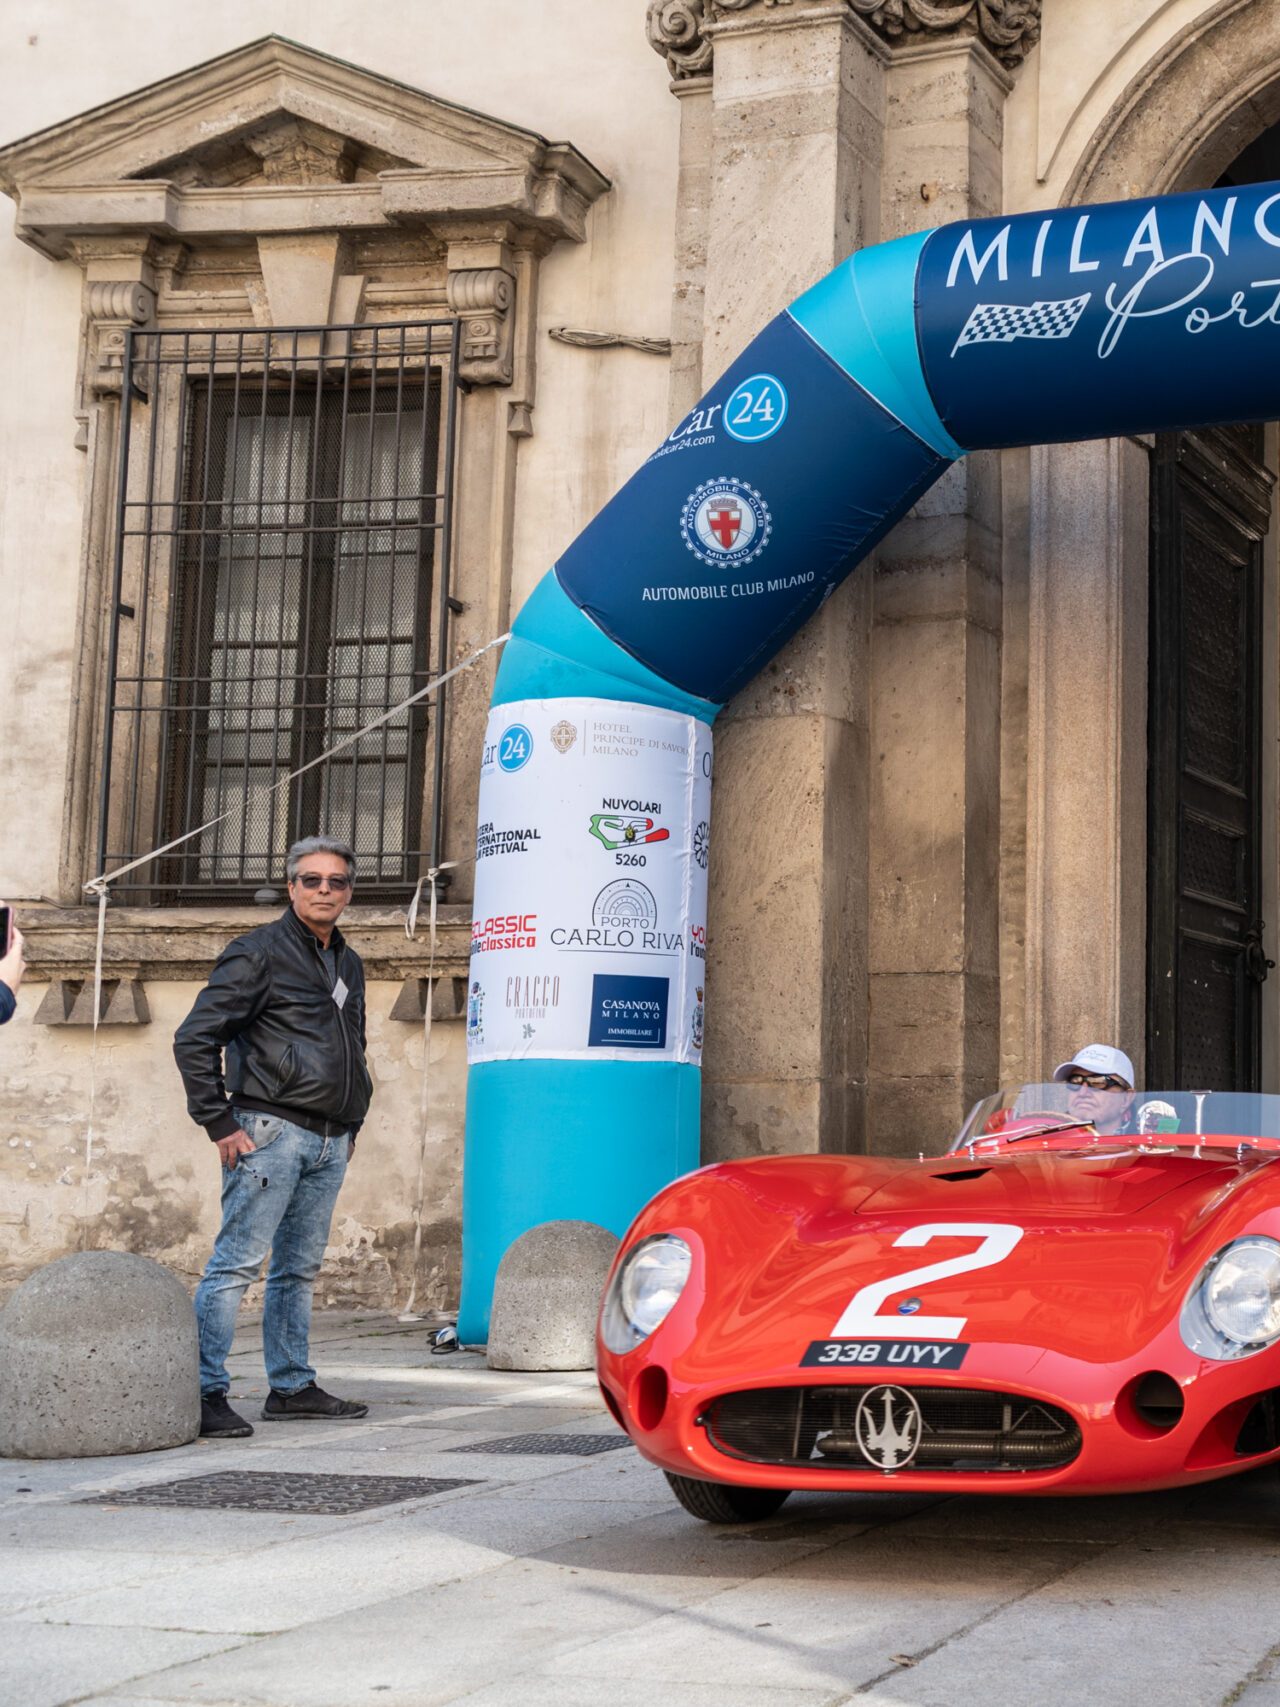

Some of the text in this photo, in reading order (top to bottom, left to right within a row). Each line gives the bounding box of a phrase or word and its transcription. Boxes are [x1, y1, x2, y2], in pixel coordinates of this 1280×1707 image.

[733, 387, 775, 424] 24
[687, 484, 764, 530] AUTOMOBILE CLUB
[705, 547, 750, 561] MILANO
[642, 586, 728, 601] AUTOMOBILE
[731, 582, 764, 597] CLUB
[767, 571, 815, 592] MILANO
[593, 722, 632, 734] HOTEL
[502, 733, 526, 761] 24
[593, 733, 646, 747] PRINCIPE
[649, 739, 659, 749] DI
[593, 745, 639, 757] MILANO
[602, 798, 662, 815] NUVOLARI
[615, 853, 647, 867] 5260
[601, 916, 650, 929] PORTO
[550, 928, 634, 948] CARLO
[643, 932, 684, 950] RIVA
[506, 975, 560, 1008] CRACCO
[602, 999, 661, 1011] CASANOVA
[602, 1010, 661, 1020] MILANO
[607, 1027, 653, 1037] IMMOBILIARE
[831, 1223, 1025, 1340] 2
[818, 1344, 954, 1365] 338 UYY
